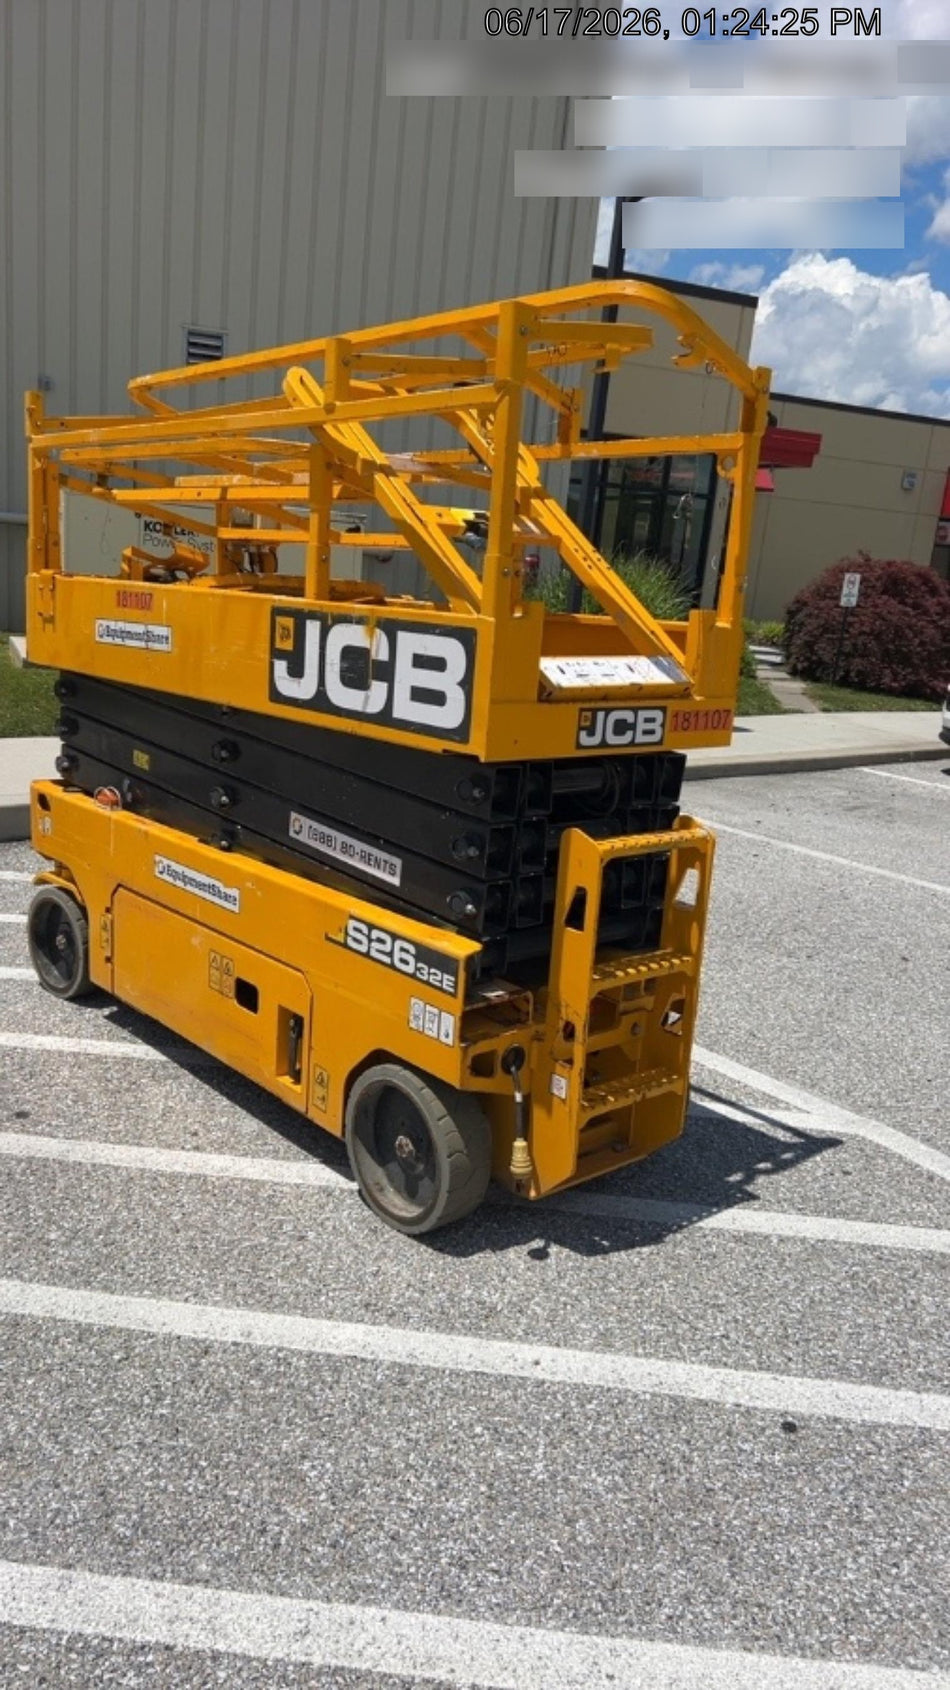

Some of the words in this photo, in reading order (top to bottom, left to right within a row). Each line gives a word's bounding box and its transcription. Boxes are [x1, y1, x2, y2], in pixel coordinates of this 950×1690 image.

[116, 590, 153, 612] 181107
[106, 624, 169, 645] EquipmentShare
[273, 618, 467, 730] JCB
[579, 709, 664, 747] JCB
[672, 709, 732, 732] 181107
[166, 864, 238, 906] EquipmentShare
